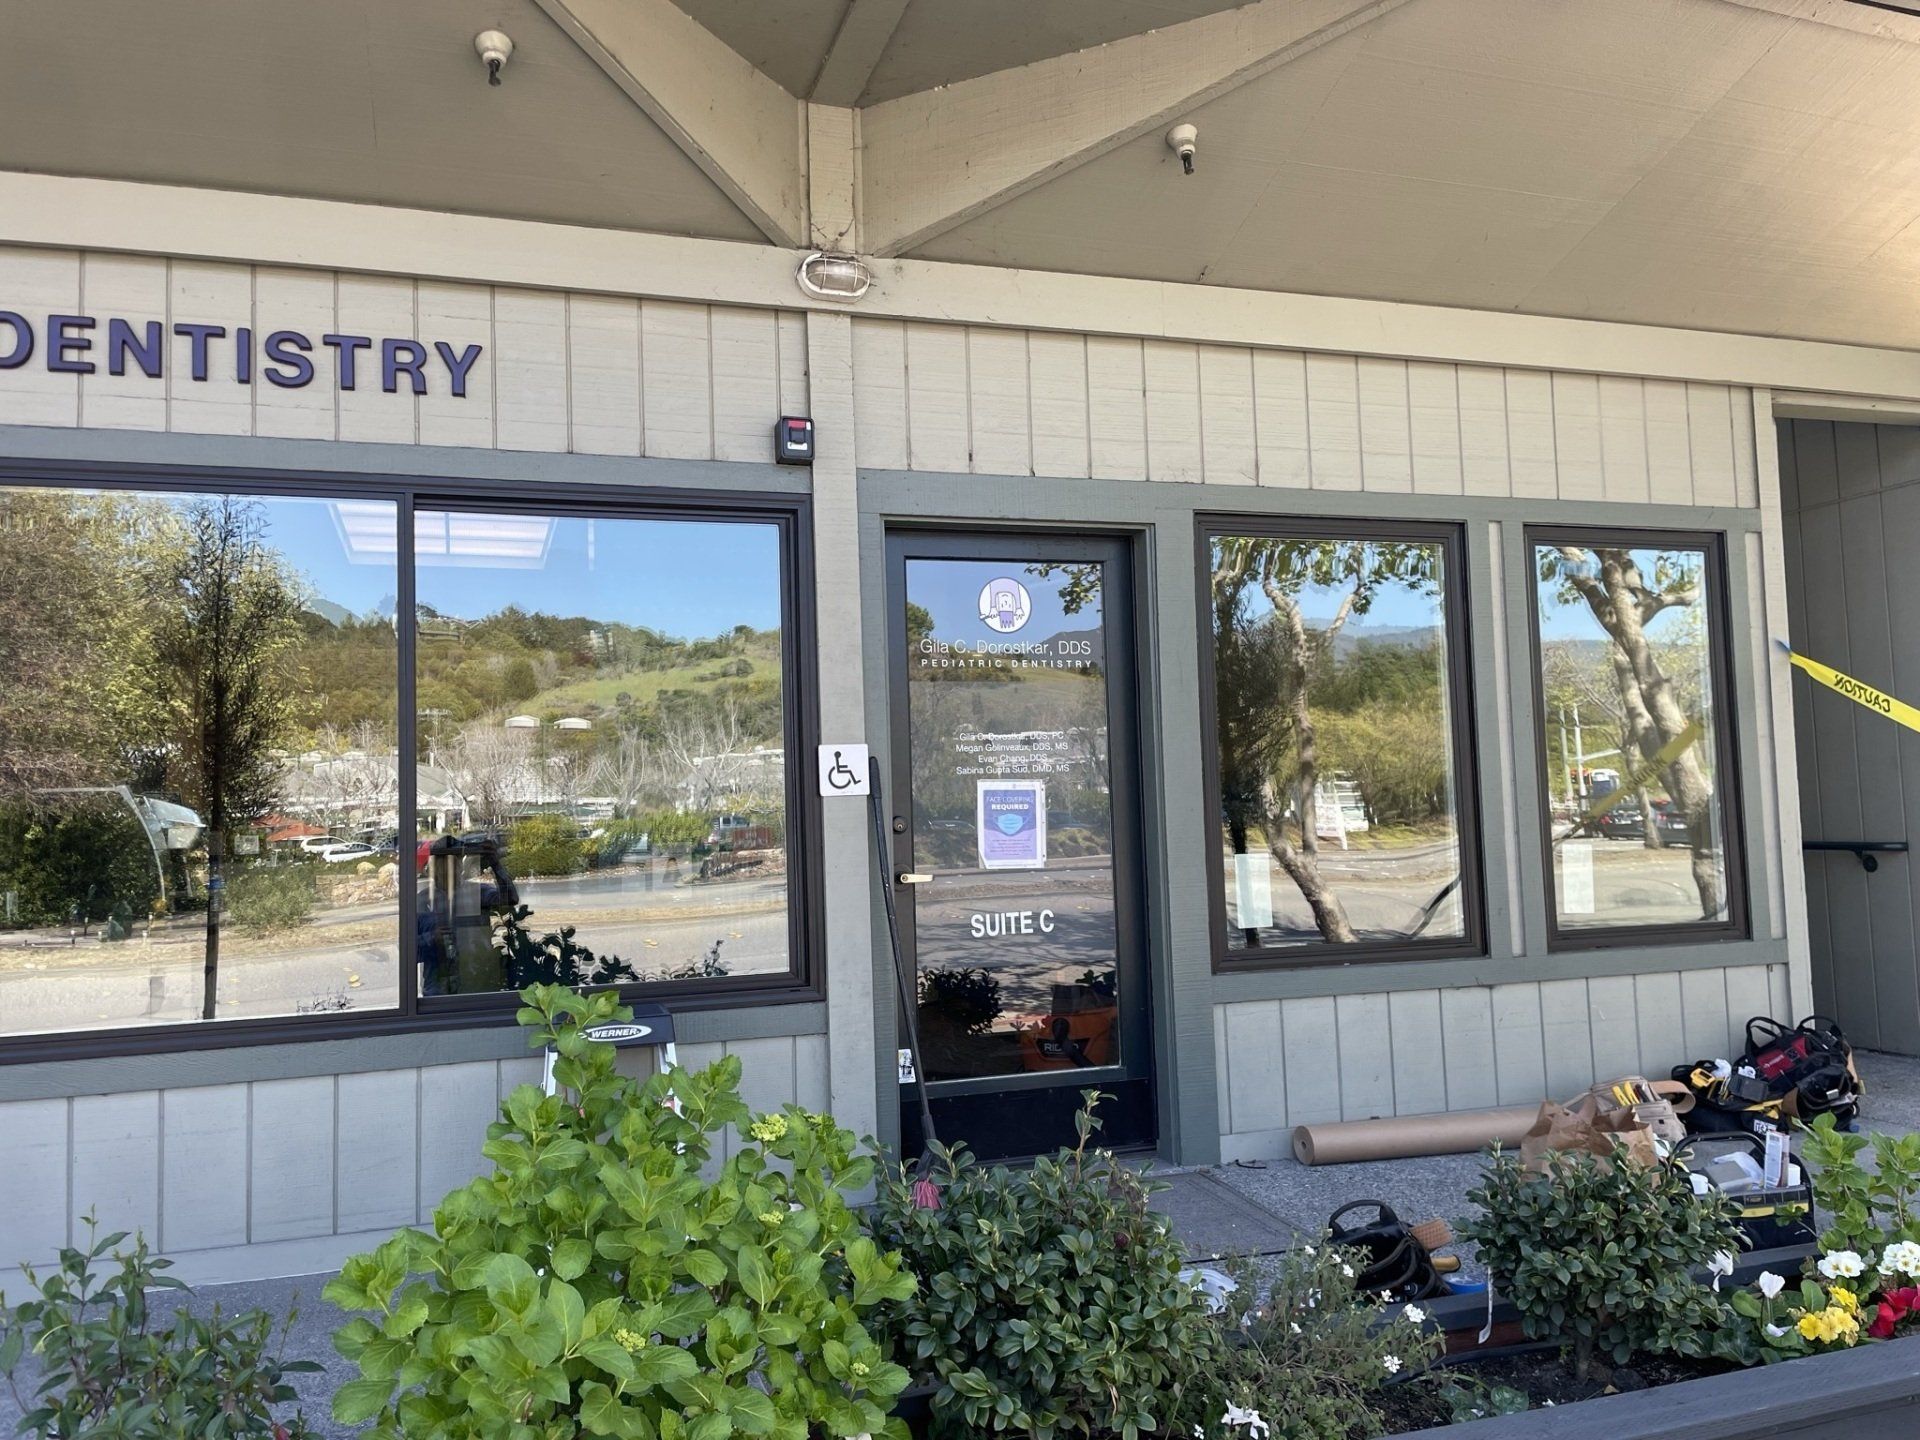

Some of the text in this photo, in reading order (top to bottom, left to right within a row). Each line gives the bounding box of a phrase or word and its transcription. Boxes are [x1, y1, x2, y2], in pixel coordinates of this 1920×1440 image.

[0, 310, 483, 398] DENTISTRY
[920, 638, 1091, 656] Gila C. Dorostkar, DDS
[921, 659, 1092, 668] PEDIATRIC DENTISTRY
[956, 744, 983, 754] Megan
[1055, 742, 1068, 751] MS
[978, 754, 998, 763] Evan
[956, 766, 984, 775] Sabina
[986, 765, 1010, 776] Gupta
[1056, 763, 1070, 773] MS
[970, 909, 1055, 938] SUITE C
[591, 1028, 638, 1038] WERNER
